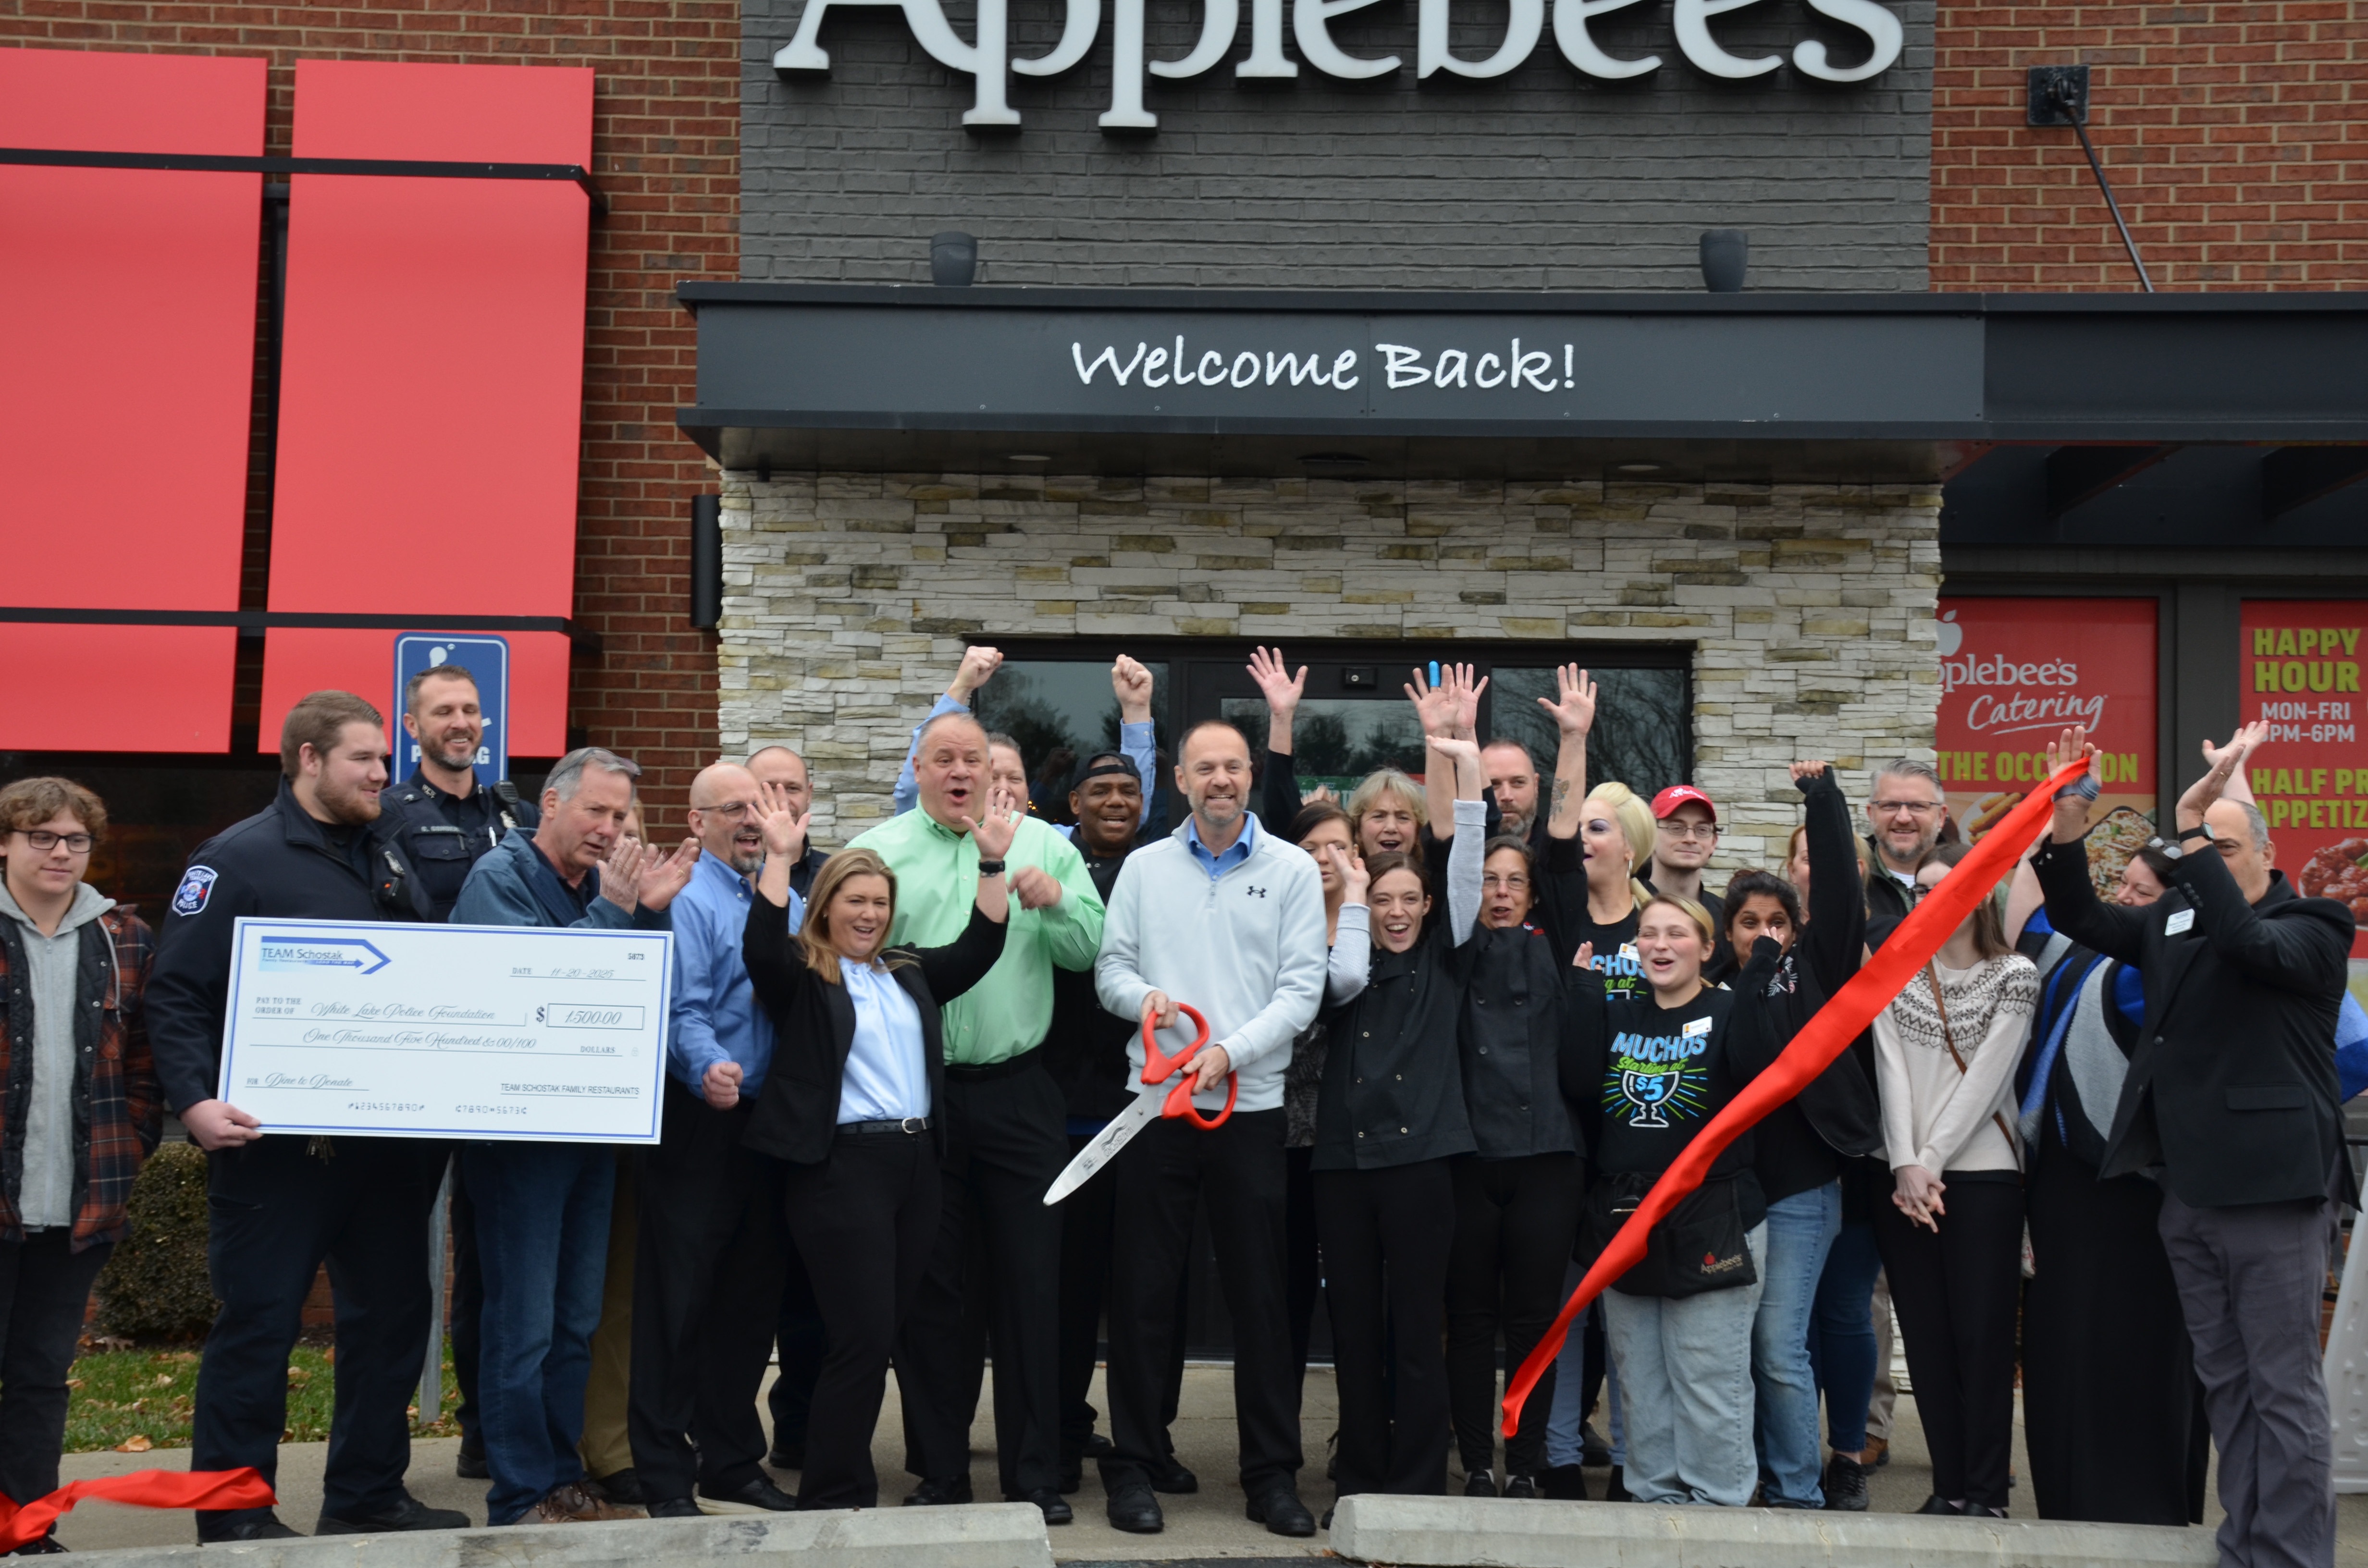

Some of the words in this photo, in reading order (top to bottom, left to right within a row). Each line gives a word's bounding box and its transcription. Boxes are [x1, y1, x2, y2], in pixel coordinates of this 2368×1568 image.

[1071, 334, 1359, 390] Welcome
[1375, 338, 1576, 392] Back!
[2254, 628, 2361, 656] HAPPY
[1936, 653, 2078, 692] plebee's
[2254, 661, 2360, 692] HOUR
[1967, 691, 2105, 734] Catering
[2261, 702, 2350, 720] MON-FRI
[1937, 751, 1988, 781] THE
[1995, 751, 2137, 783] OCCON
[2252, 768, 2328, 795] HALF
[262, 948, 294, 958] TEAM
[296, 949, 343, 960] Schostak
[1590, 954, 1647, 978] CHO
[311, 1002, 350, 1017] White
[352, 1002, 380, 1019] Lake
[383, 1003, 424, 1019] Police
[428, 1005, 495, 1020] Foundation
[536, 1005, 545, 1023] $
[303, 1028, 330, 1043] One
[332, 1029, 394, 1044] Thousand
[395, 1031, 423, 1046] Five
[425, 1032, 482, 1049] Hundred
[496, 1038, 537, 1049] 00/100
[580, 1046, 616, 1054] DOLLARS
[1610, 1031, 1709, 1063] MUCHOS
[1617, 1056, 1669, 1076] Starting
[1669, 1058, 1690, 1071] at
[265, 1072, 296, 1088] Dine
[297, 1076, 307, 1086] to
[309, 1074, 353, 1089] Donate
[501, 1083, 520, 1091] TEAM
[522, 1084, 560, 1092] SCHOSTAK
[562, 1085, 587, 1093] FAMILY
[588, 1086, 640, 1095] RESTAURANTS
[1635, 1076, 1665, 1101] $5
